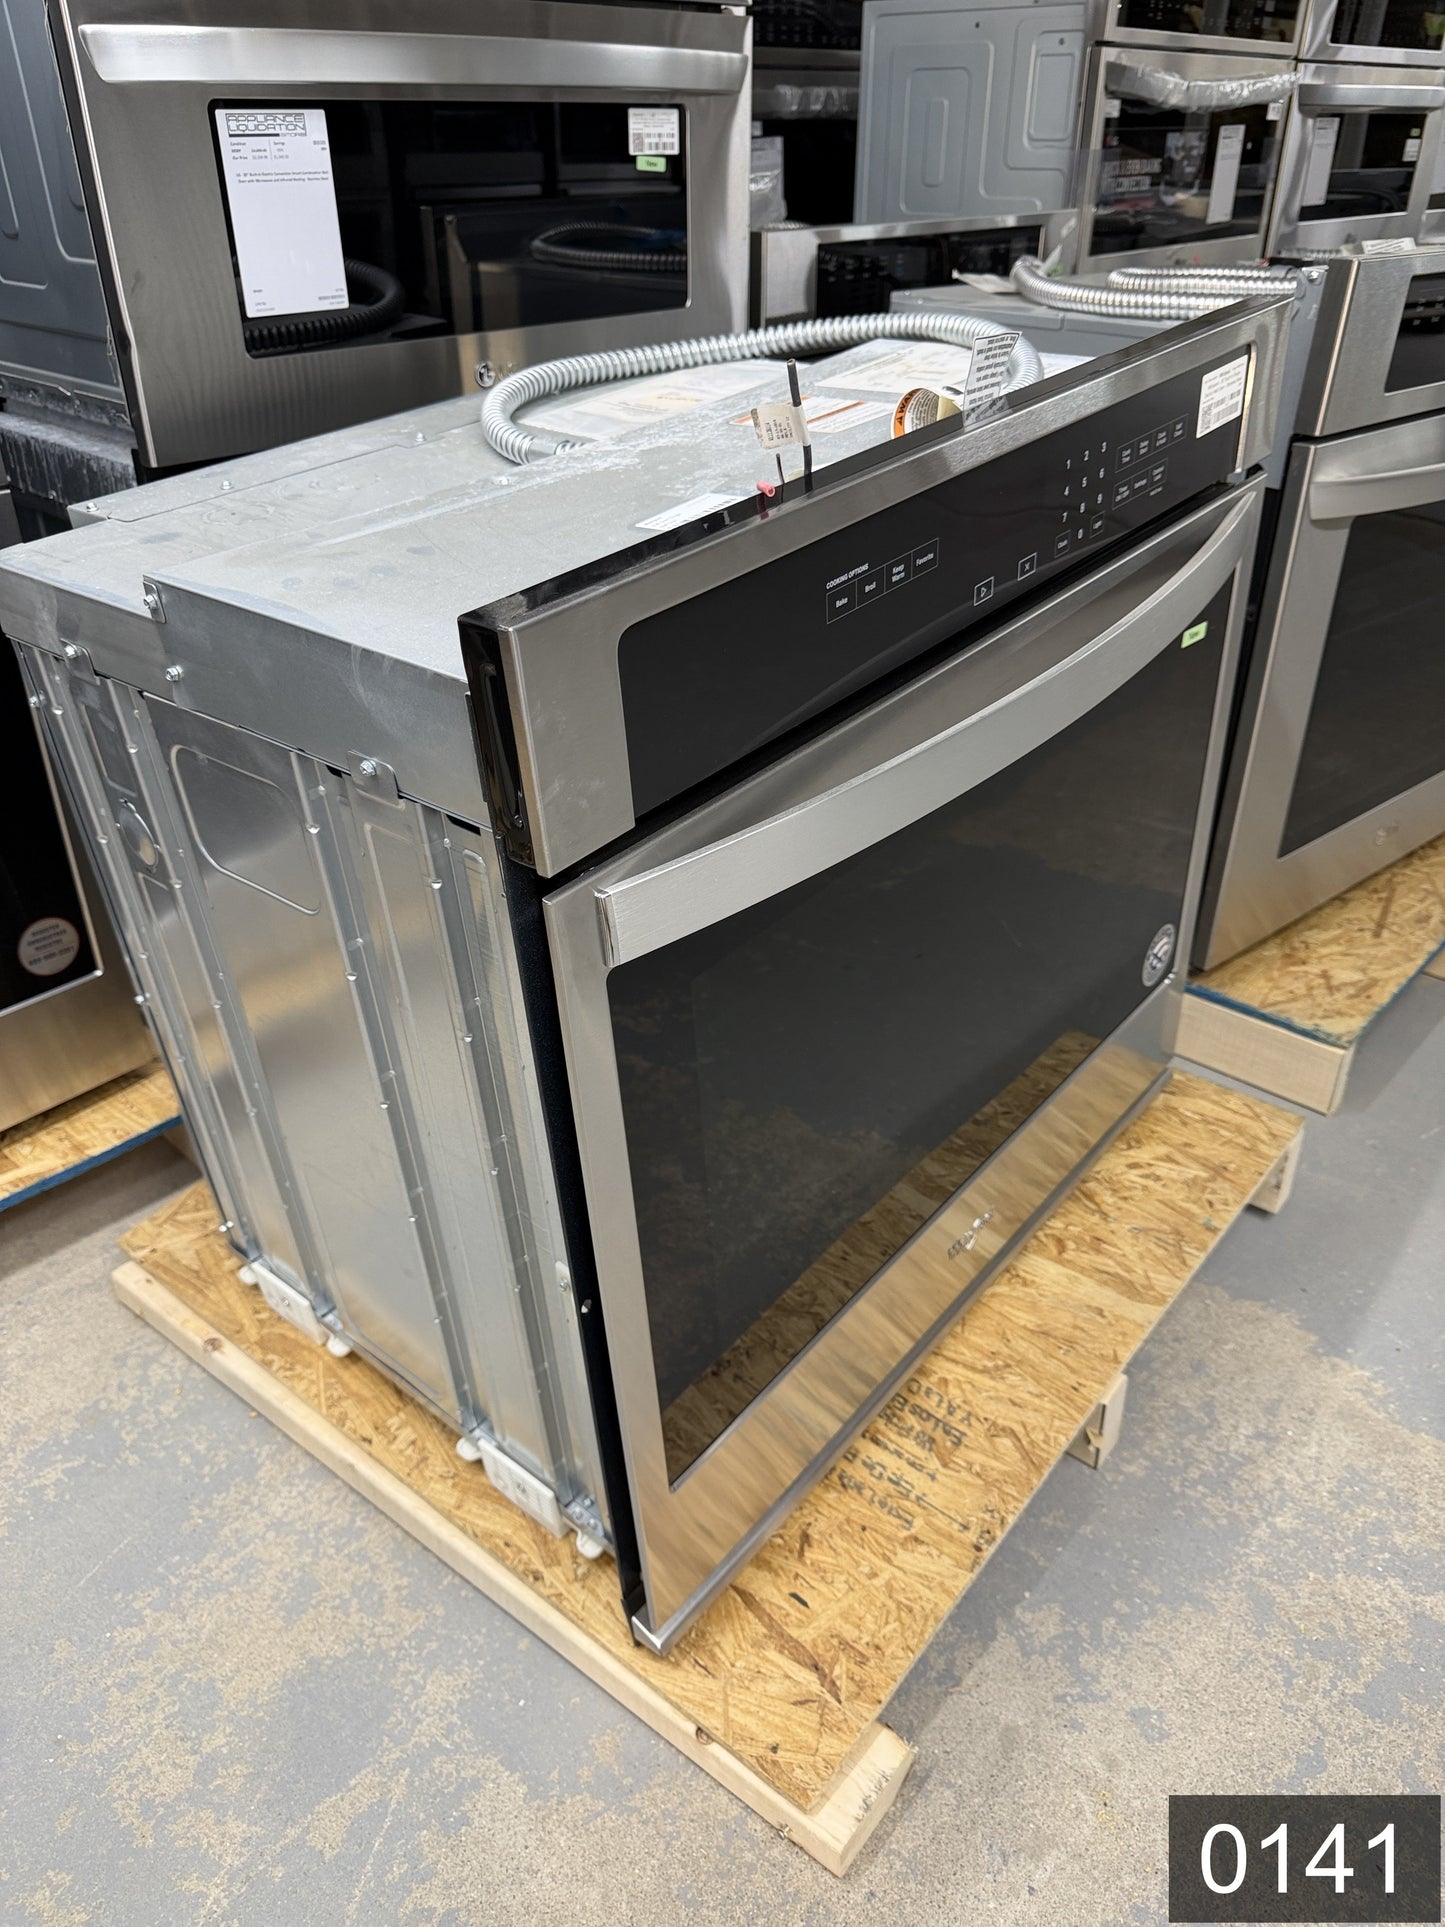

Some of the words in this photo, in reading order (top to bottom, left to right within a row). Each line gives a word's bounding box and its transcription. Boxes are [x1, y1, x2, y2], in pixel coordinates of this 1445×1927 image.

[226, 115, 304, 123] APPLIANCE
[228, 124, 305, 133] LIQUIDATION
[1101, 441, 1107, 452] 3
[1084, 450, 1089, 461] 2
[1066, 459, 1071, 470] 1
[1099, 467, 1105, 479] 6
[1082, 476, 1087, 487] 5
[1064, 485, 1070, 496] 4
[1097, 493, 1103, 504] 9
[1080, 502, 1085, 513] 8
[1062, 511, 1068, 523] 7
[1078, 528, 1083, 539] 0
[916, 553, 934, 567] Favorite
[892, 564, 904, 574] Keep
[826, 573, 848, 590] COOKING
[848, 562, 869, 578] OPTIONS
[891, 572, 905, 583] Warm
[864, 581, 876, 593] Broil
[835, 597, 848, 608] Bake
